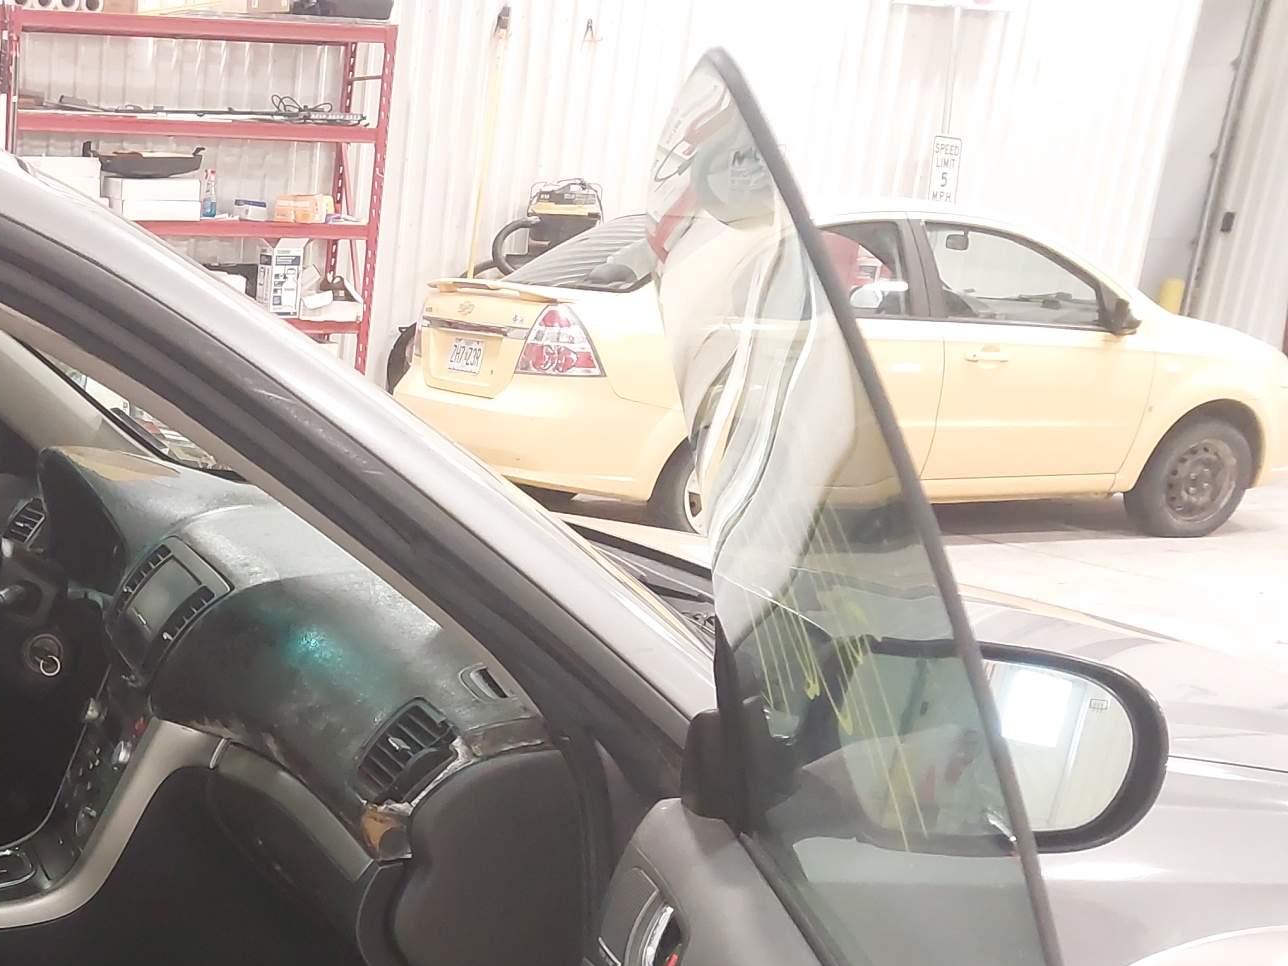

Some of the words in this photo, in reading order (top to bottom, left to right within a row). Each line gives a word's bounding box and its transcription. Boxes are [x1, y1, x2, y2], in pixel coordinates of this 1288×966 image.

[935, 143, 959, 156] SPEED
[936, 157, 955, 168] LIMIT
[940, 171, 948, 188] 5
